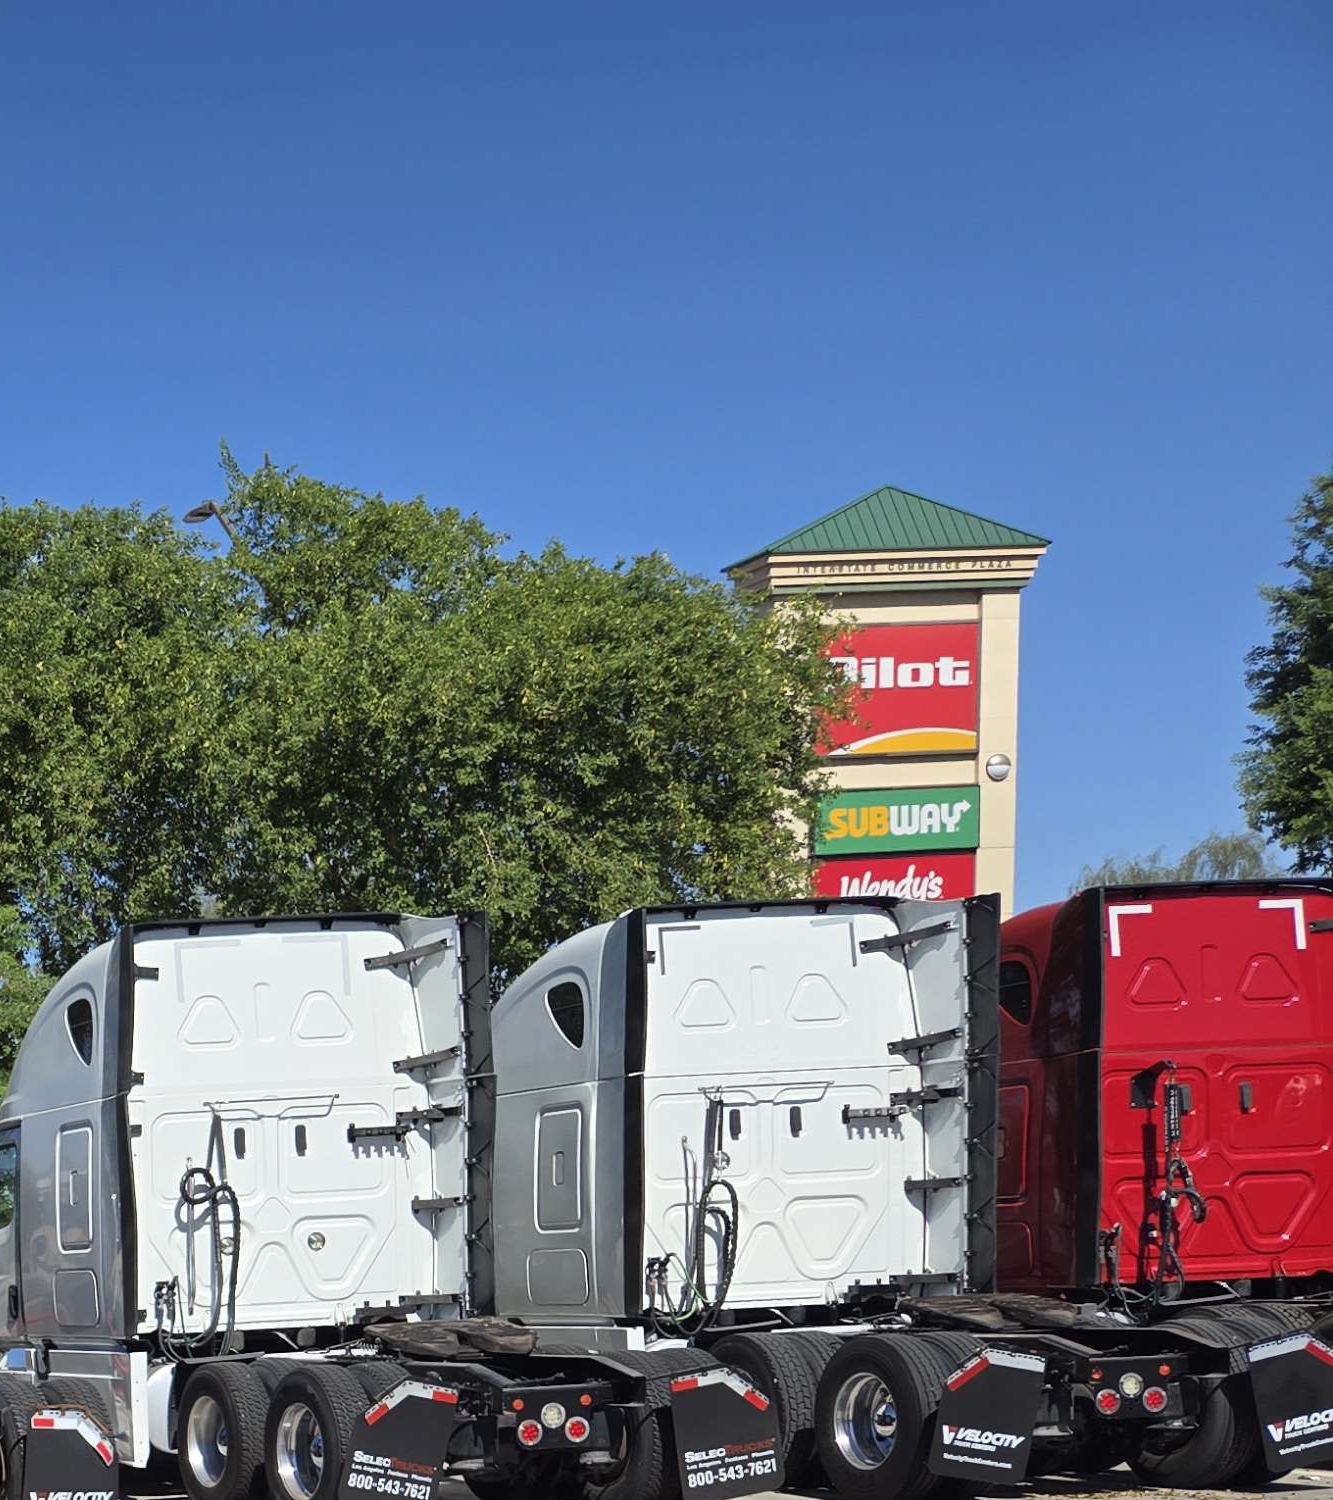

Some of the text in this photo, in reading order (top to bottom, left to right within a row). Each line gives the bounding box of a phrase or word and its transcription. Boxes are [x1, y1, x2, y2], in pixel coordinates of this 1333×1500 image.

[888, 561, 960, 571] COMMERCE
[971, 560, 1012, 569] PLAZA
[825, 799, 971, 840] SUBWAY
[840, 864, 944, 901] Wendy's
[1285, 1408, 1333, 1432] VELOC
[956, 1427, 1026, 1449] VELOCITY
[347, 1472, 431, 1500] 800-543-7621
[687, 1458, 777, 1488] 800-543-7621
